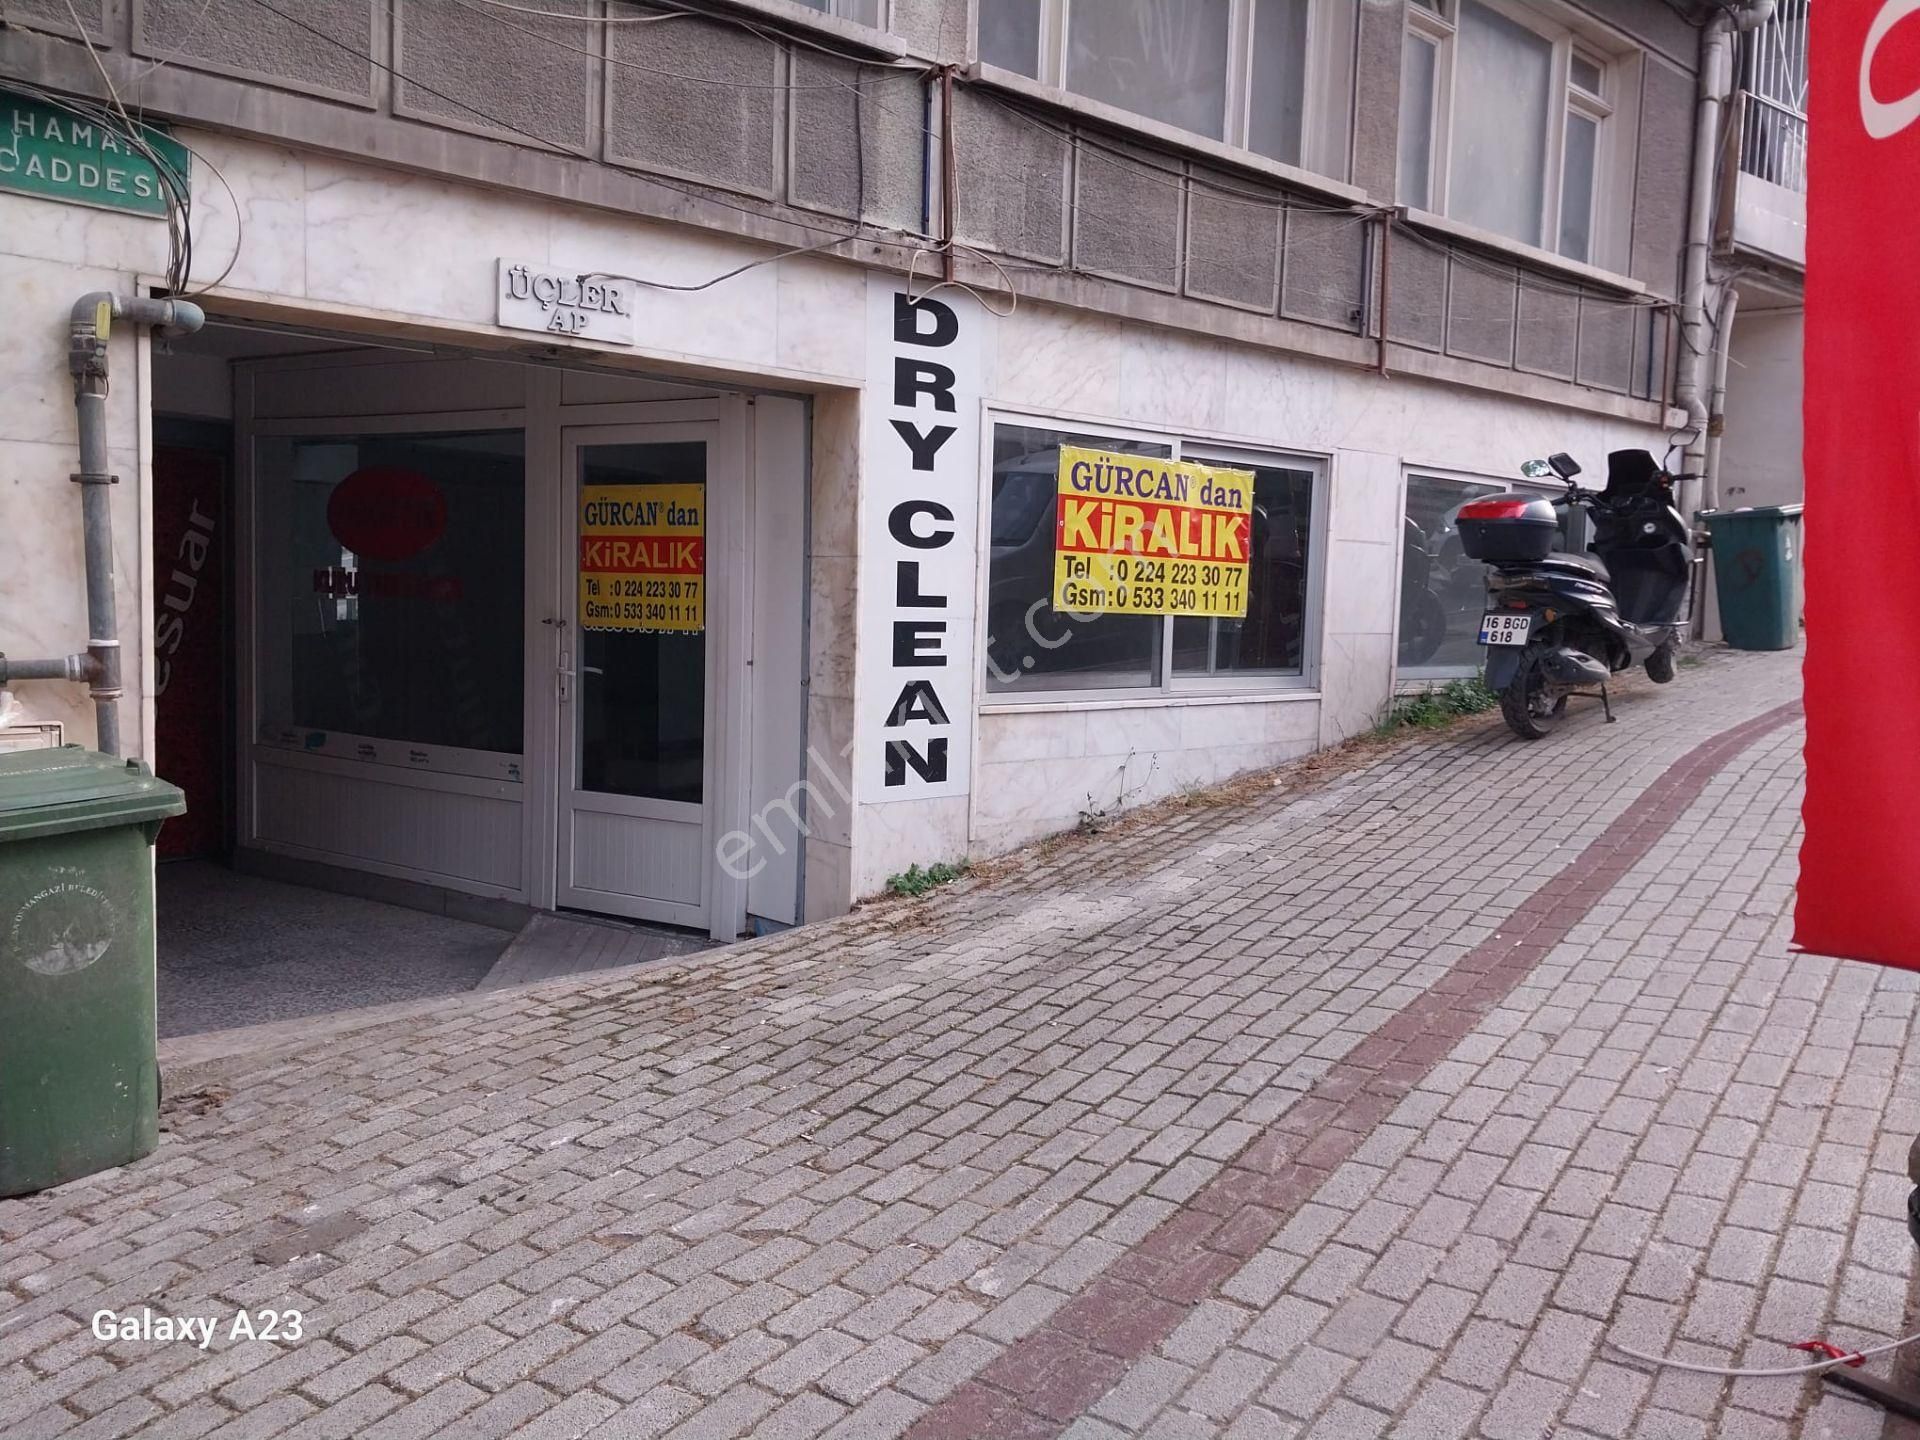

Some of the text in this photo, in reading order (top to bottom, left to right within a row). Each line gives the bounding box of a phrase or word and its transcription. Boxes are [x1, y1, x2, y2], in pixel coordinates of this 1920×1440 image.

[13, 109, 133, 156] HAMA
[508, 265, 625, 316] ÜÇLER
[547, 308, 590, 334] AP
[1200, 478, 1243, 509] dan
[667, 500, 699, 527] dan
[883, 292, 959, 787] DRY CLEAN
[1063, 555, 1091, 580] Tel
[1134, 560, 1165, 583] 224
[1171, 563, 1197, 585] 223
[1202, 565, 1220, 586] 30
[1225, 567, 1242, 587] 77
[586, 579, 600, 597] Tel
[625, 580, 643, 598] 224
[646, 581, 666, 598] 223
[669, 582, 681, 599] 30
[685, 582, 698, 599] 77
[1133, 586, 1164, 609] 533
[1170, 588, 1196, 610] 340
[1202, 590, 1218, 611] 11
[1225, 591, 1241, 612] 11
[624, 603, 643, 619] 533
[646, 603, 666, 620] 340
[669, 605, 680, 621] 11
[685, 605, 697, 622] 11
[1486, 617, 1529, 630] 16 BGD
[1490, 630, 1513, 643] 618
